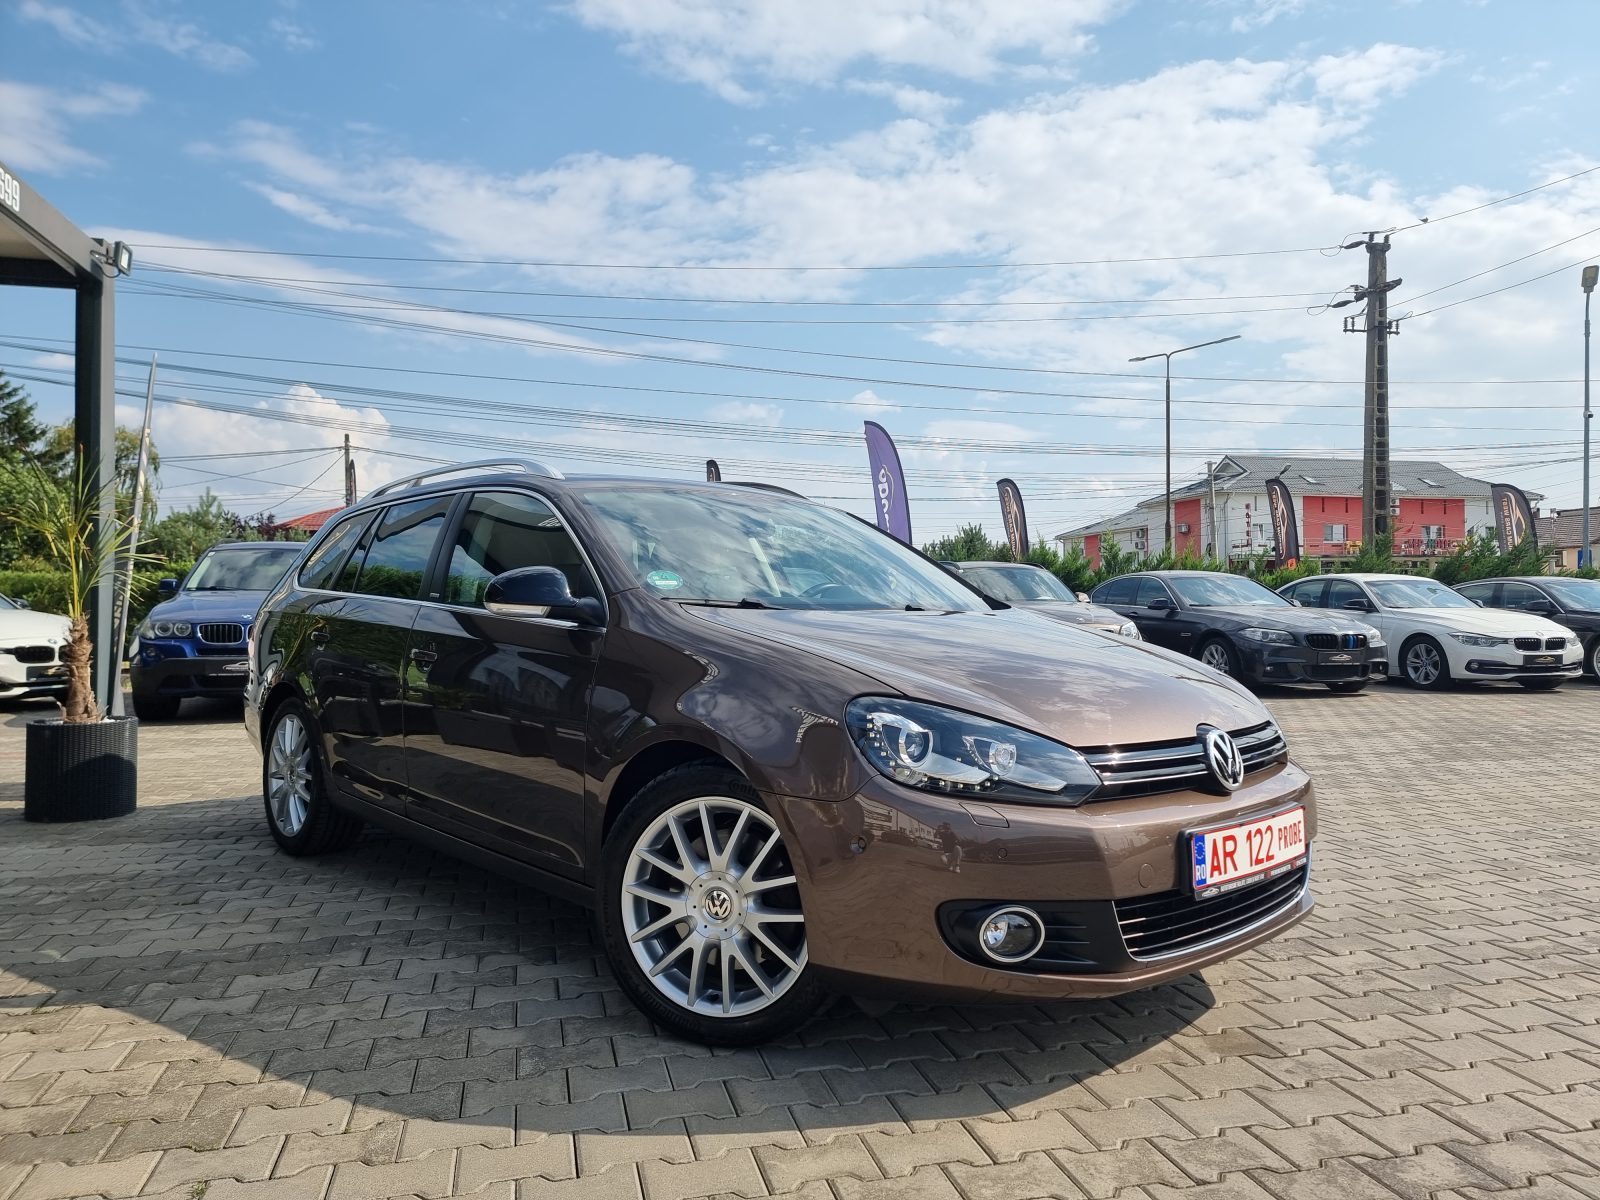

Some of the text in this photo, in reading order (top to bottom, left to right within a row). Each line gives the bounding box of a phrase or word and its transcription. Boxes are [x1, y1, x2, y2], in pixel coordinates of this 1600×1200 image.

[1209, 834, 1238, 878] AR
[1245, 824, 1275, 867] 122
[1278, 821, 1302, 850] PROBE
[1195, 864, 1207, 881] RO
